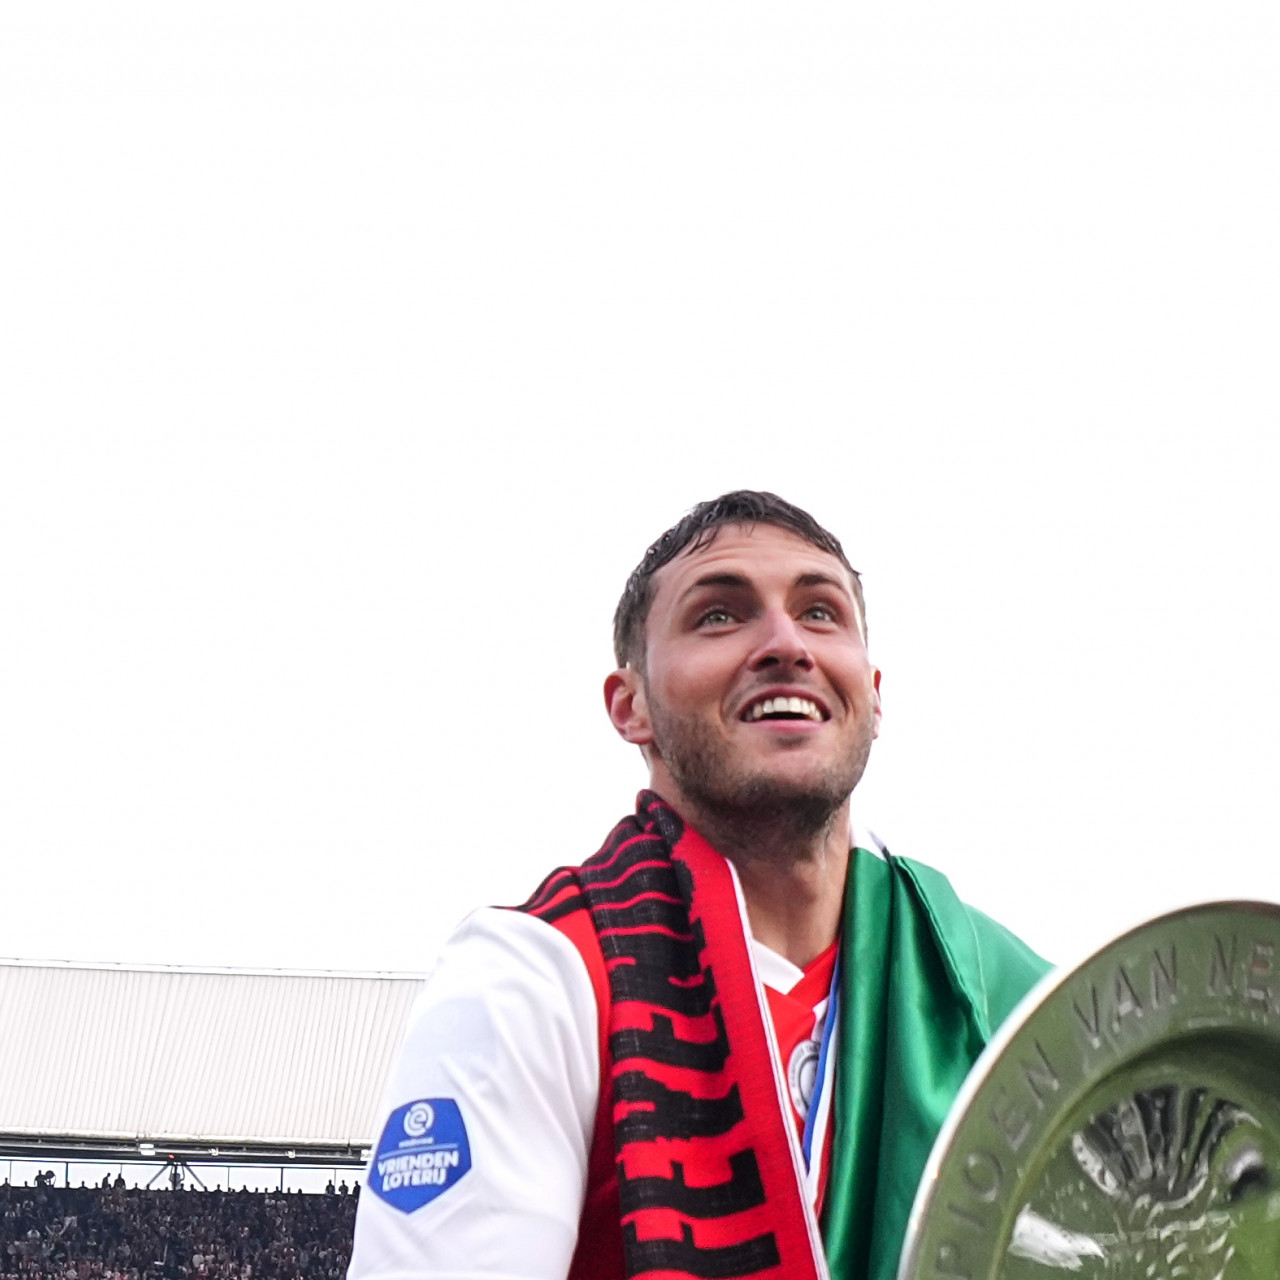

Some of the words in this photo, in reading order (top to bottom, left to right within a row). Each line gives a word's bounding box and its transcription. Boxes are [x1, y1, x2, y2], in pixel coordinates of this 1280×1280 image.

[1073, 944, 1179, 1049] VAN
[377, 1150, 459, 1176] VRIENDEN
[382, 1168, 447, 1192] LOTERIJ
